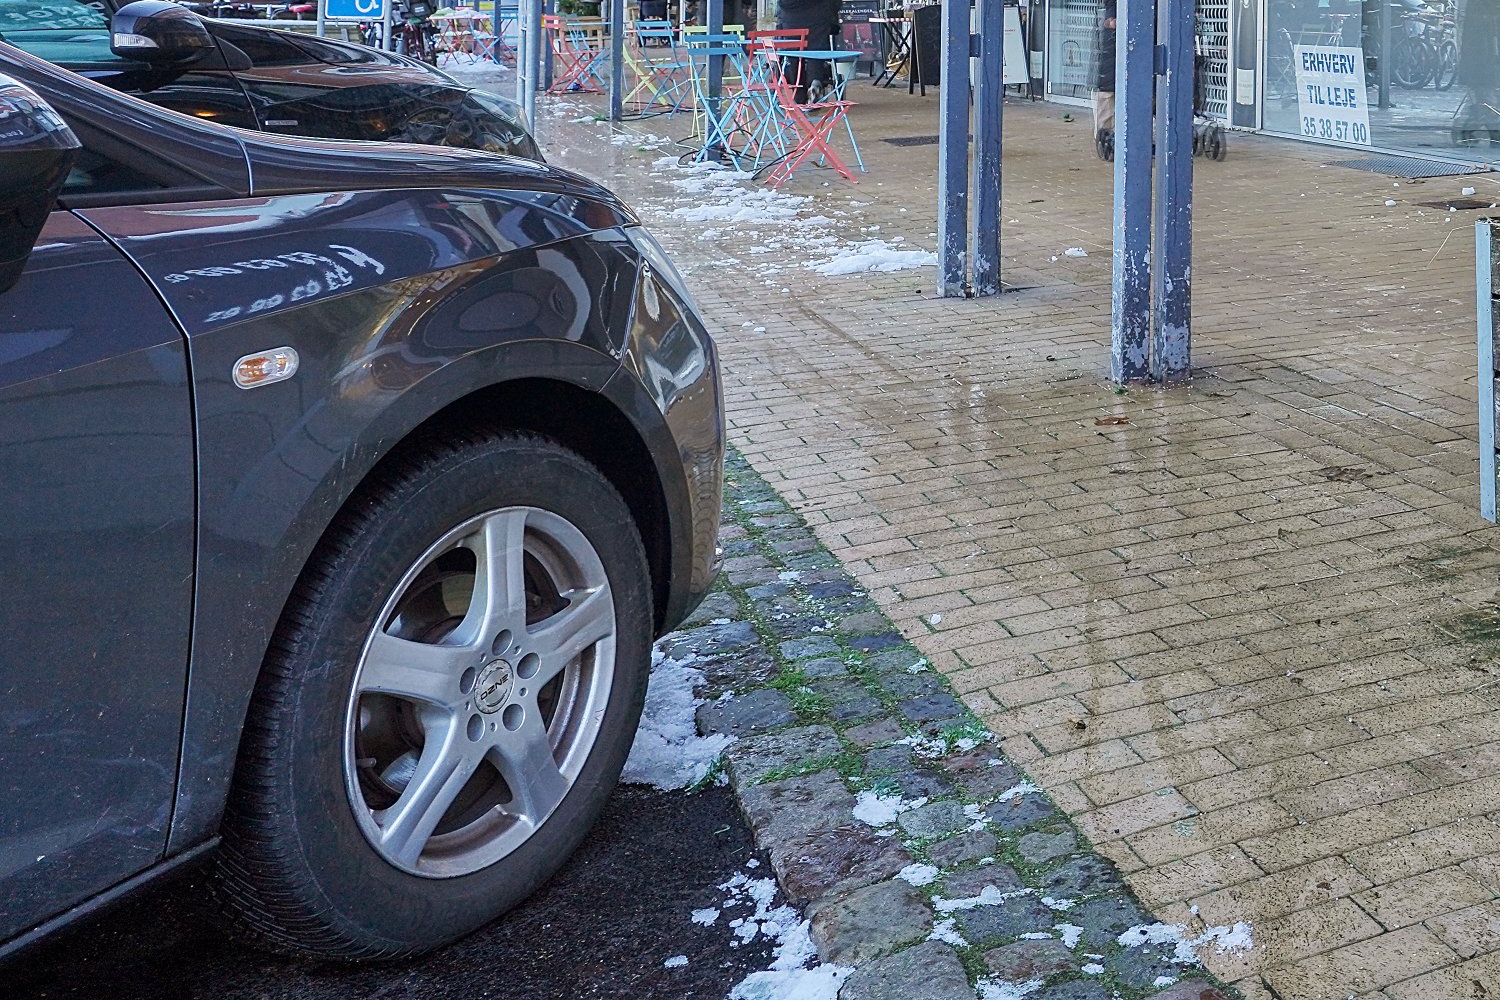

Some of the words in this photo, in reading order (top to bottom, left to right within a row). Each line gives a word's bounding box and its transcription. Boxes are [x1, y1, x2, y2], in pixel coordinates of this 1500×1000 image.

[1302, 53, 1354, 74] ERHVERV
[1307, 85, 1325, 104] TIL
[1327, 86, 1356, 108] LEJE
[1303, 116, 1316, 136] 35
[1319, 118, 1333, 138] 38
[1336, 120, 1348, 140] 57
[1352, 122, 1367, 143] 00
